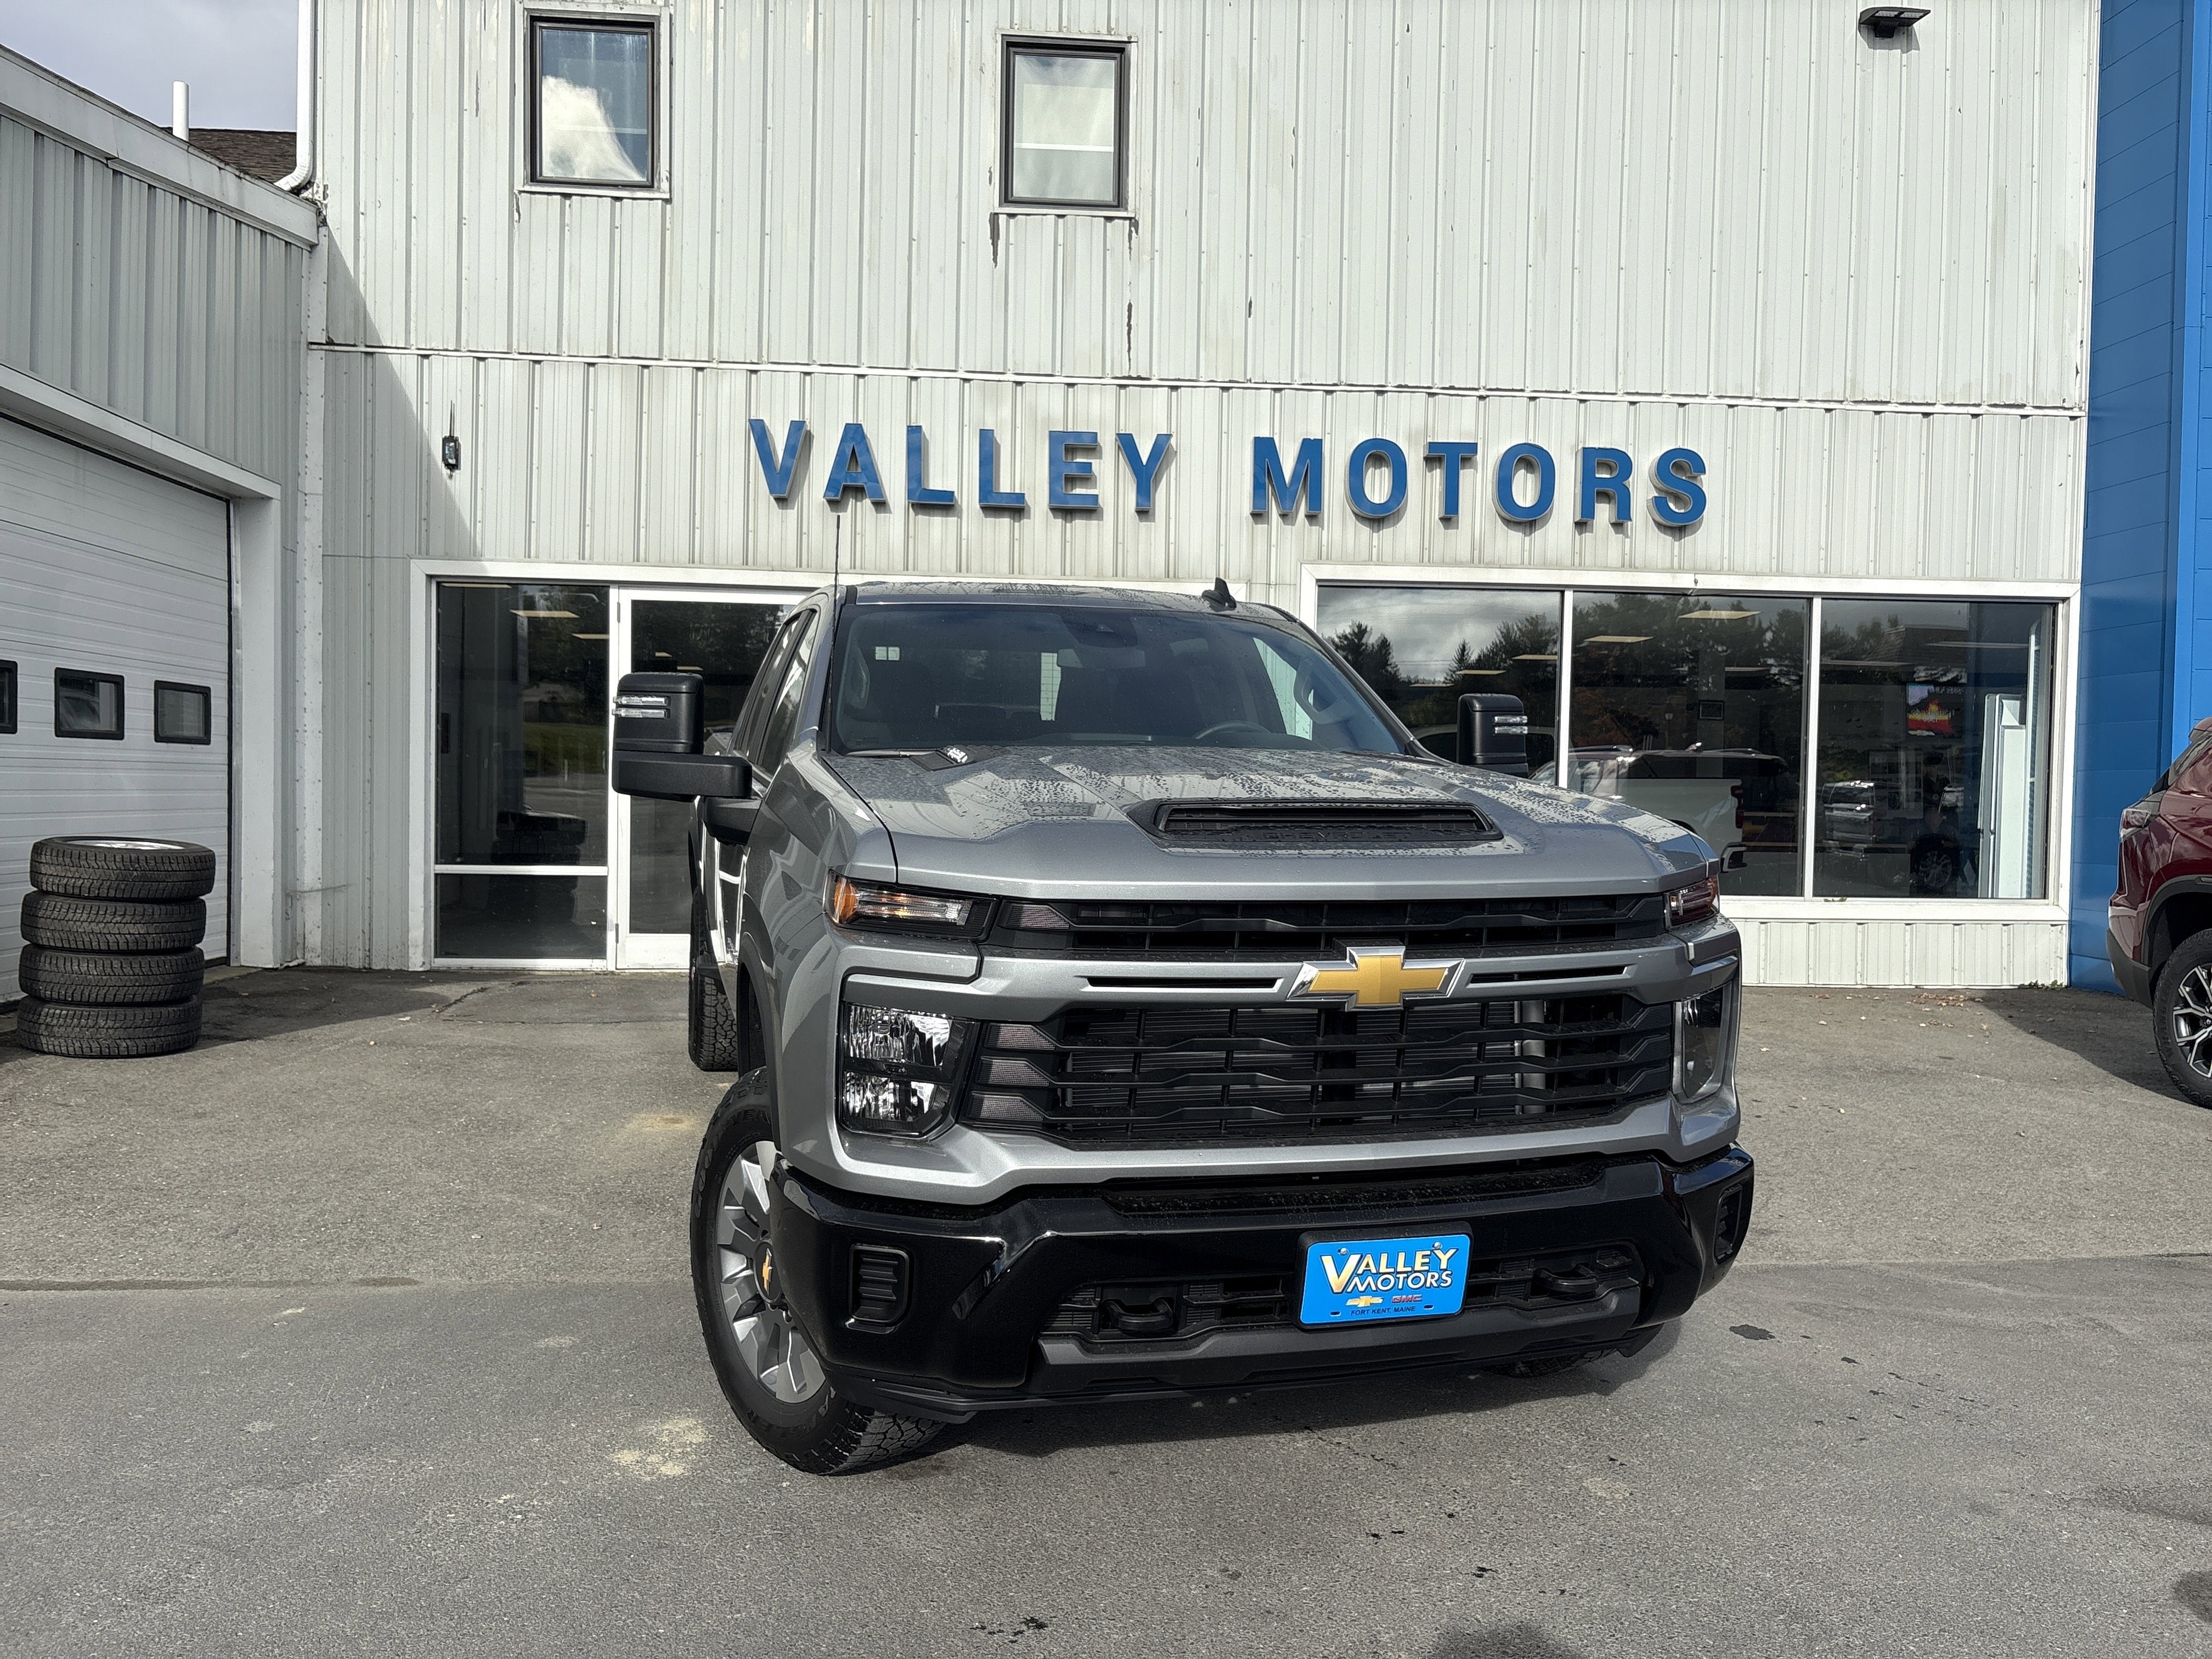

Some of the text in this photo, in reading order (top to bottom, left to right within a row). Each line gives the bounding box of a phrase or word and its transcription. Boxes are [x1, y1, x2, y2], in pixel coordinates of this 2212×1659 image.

[748, 419, 1707, 526] VALLEY MOTORS
[1319, 1248, 1459, 1294] VALLEY
[1345, 1270, 1453, 1293] MOTORS
[1392, 1294, 1423, 1303] GMC
